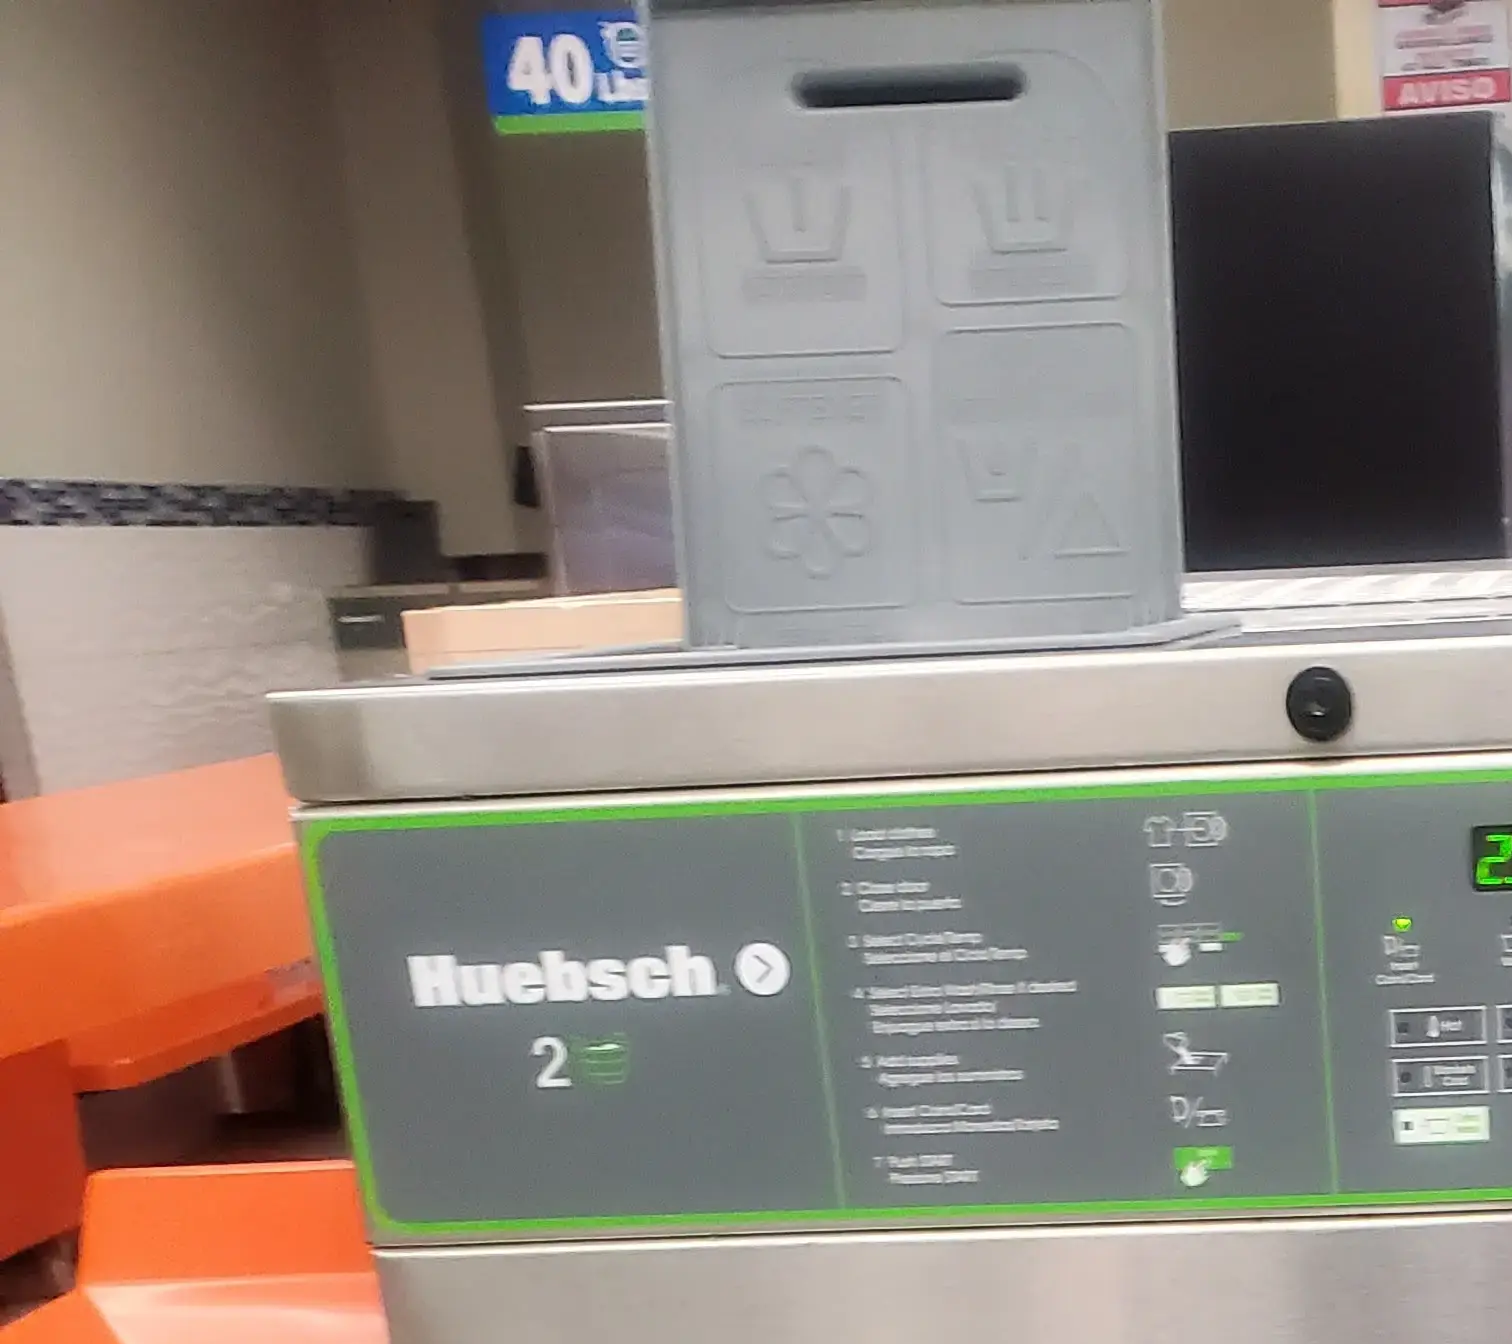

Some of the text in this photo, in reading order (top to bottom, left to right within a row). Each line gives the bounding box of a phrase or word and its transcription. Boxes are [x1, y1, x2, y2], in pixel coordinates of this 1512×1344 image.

[507, 34, 593, 105] 40
[1398, 76, 1497, 107] AVISO
[405, 943, 719, 1007] Huebsch
[531, 1036, 572, 1089] 2
